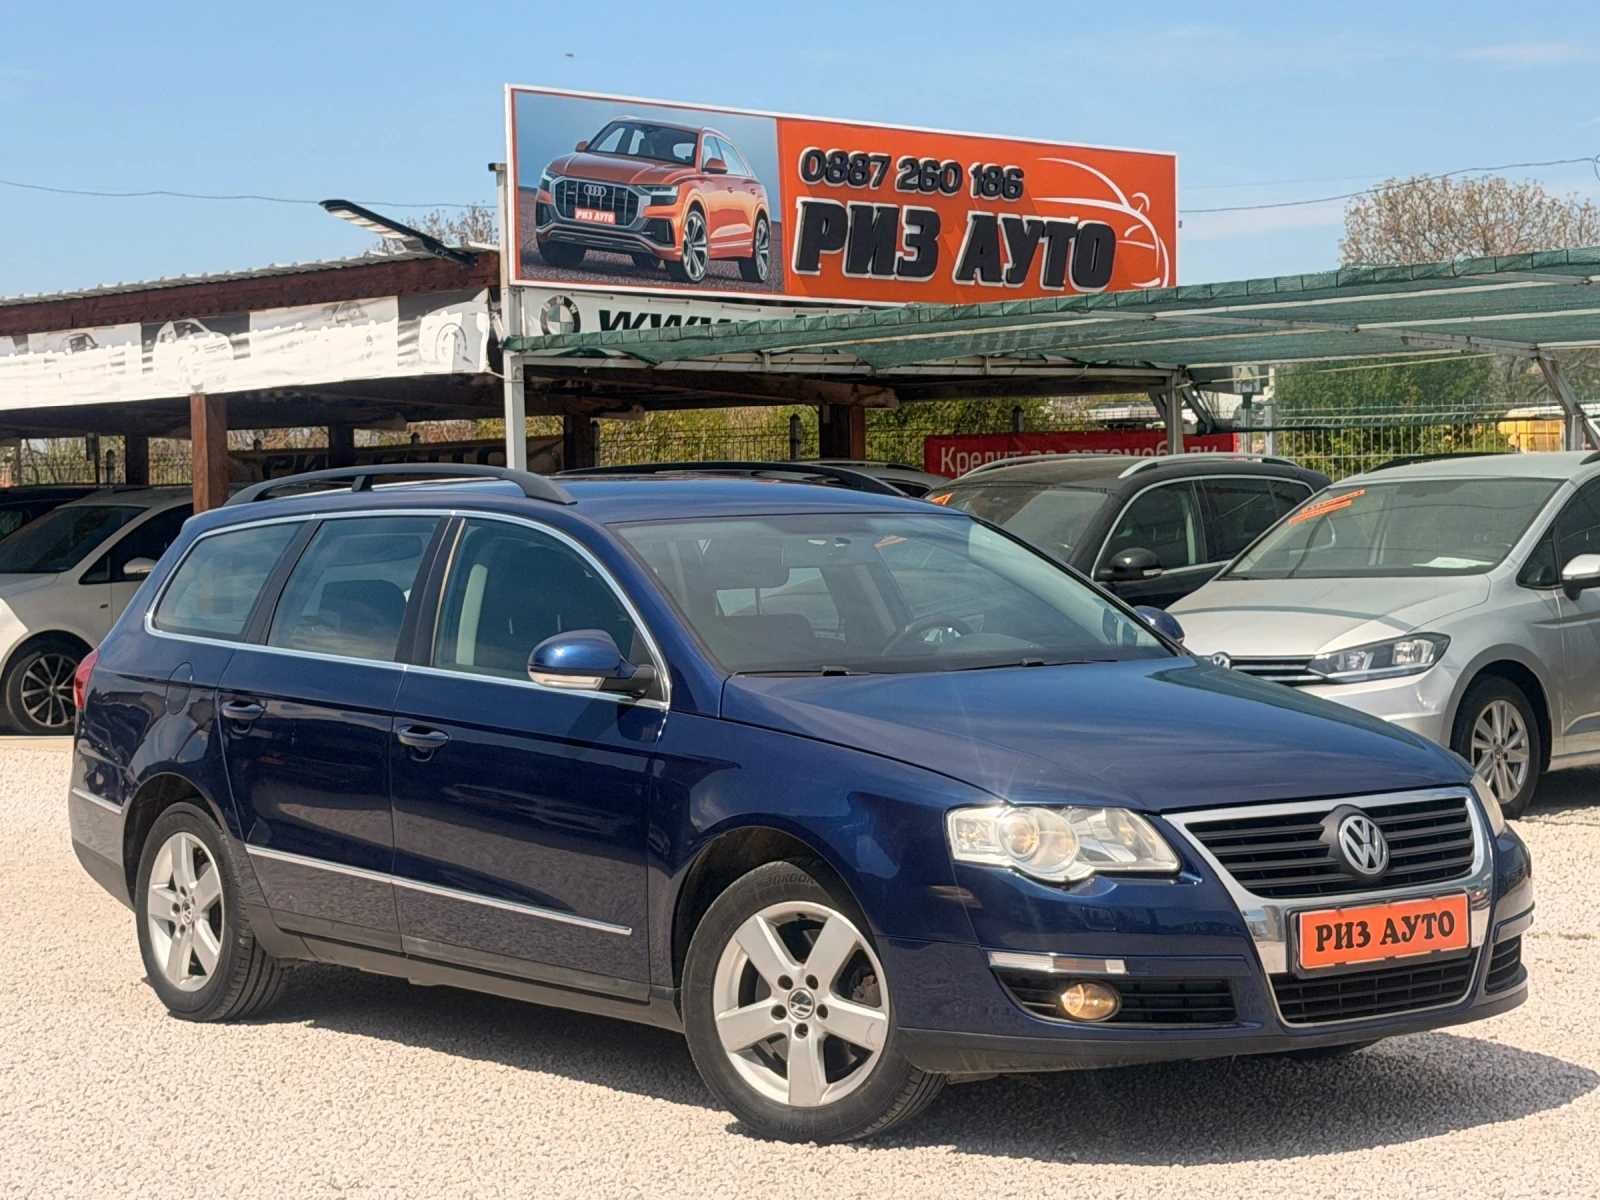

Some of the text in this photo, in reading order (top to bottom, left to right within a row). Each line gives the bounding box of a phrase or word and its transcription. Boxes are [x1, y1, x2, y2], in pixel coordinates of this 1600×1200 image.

[799, 147, 1025, 202] 0887 260 186
[792, 196, 1117, 293] РИЗ АУТО
[1315, 910, 1455, 952] РИЗ АУТО
